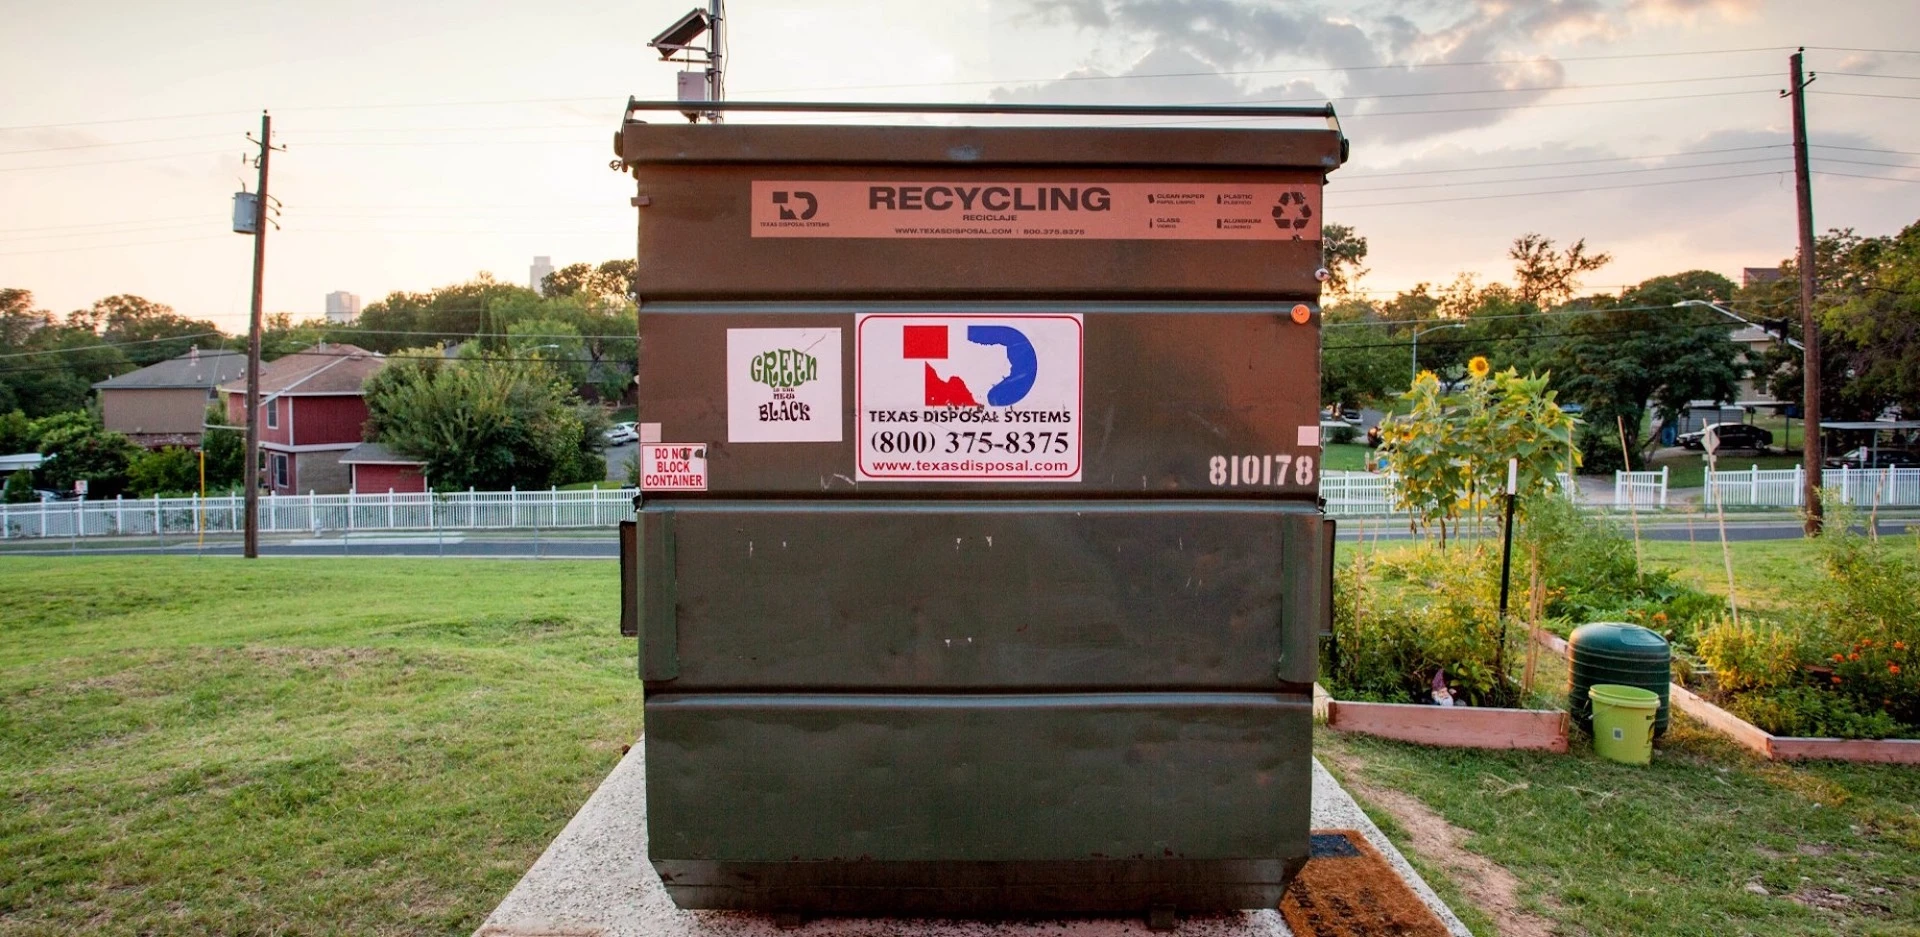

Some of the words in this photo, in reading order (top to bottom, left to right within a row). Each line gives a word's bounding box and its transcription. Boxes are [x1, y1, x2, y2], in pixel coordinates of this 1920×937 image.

[869, 186, 1111, 211] RECYCLING
[759, 400, 811, 421] BLACK
[869, 410, 918, 423] TEXAS
[923, 410, 999, 424] DISPOSAL
[1004, 410, 1072, 424] SYSTEMS
[871, 431, 936, 454] (800)
[944, 431, 1069, 455] 375-8375
[655, 448, 669, 460] DO
[657, 461, 690, 473] BLOCK
[873, 460, 1069, 474] www.texasdisposal.com
[1209, 455, 1313, 486] 810178
[645, 474, 703, 487] CONTAINER
